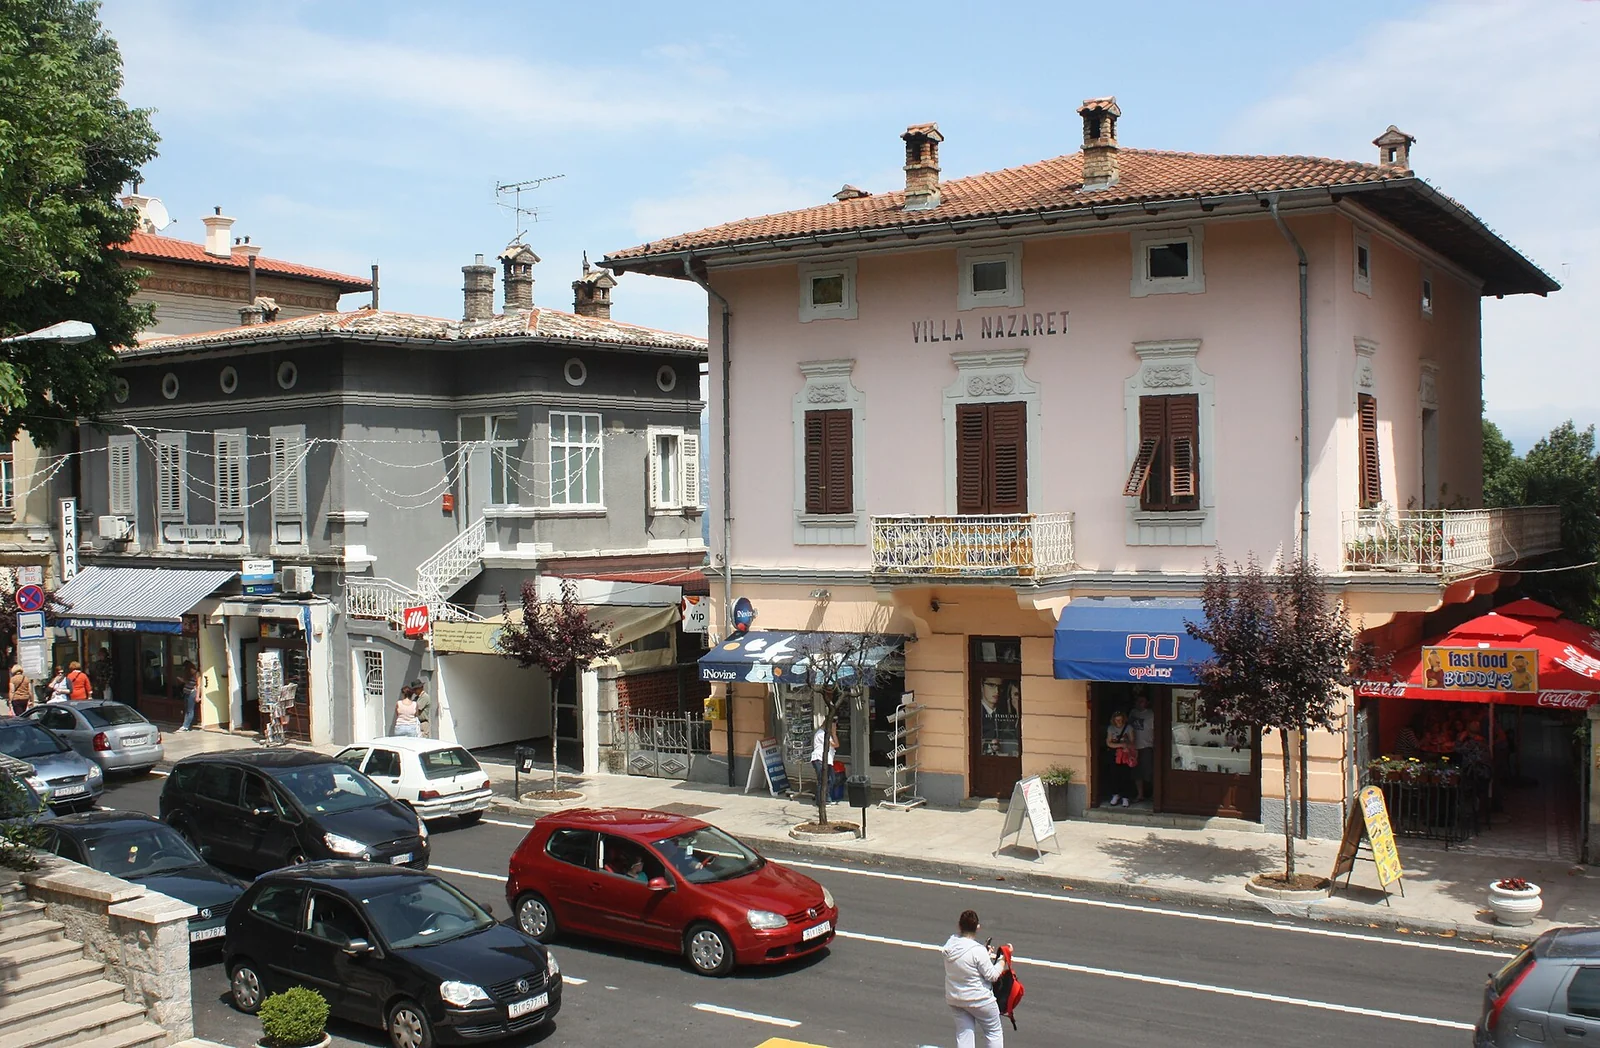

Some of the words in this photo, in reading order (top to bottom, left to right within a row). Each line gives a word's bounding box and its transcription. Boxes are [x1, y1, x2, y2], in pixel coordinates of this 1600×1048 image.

[912, 318, 963, 343] VILLA
[981, 311, 1069, 338] NAZARET
[64, 502, 75, 578] PEKARA
[179, 528, 198, 539] VILLA
[407, 610, 427, 631] illy
[691, 610, 705, 622] vip
[1448, 651, 1475, 667] fast
[1477, 651, 1508, 668] food
